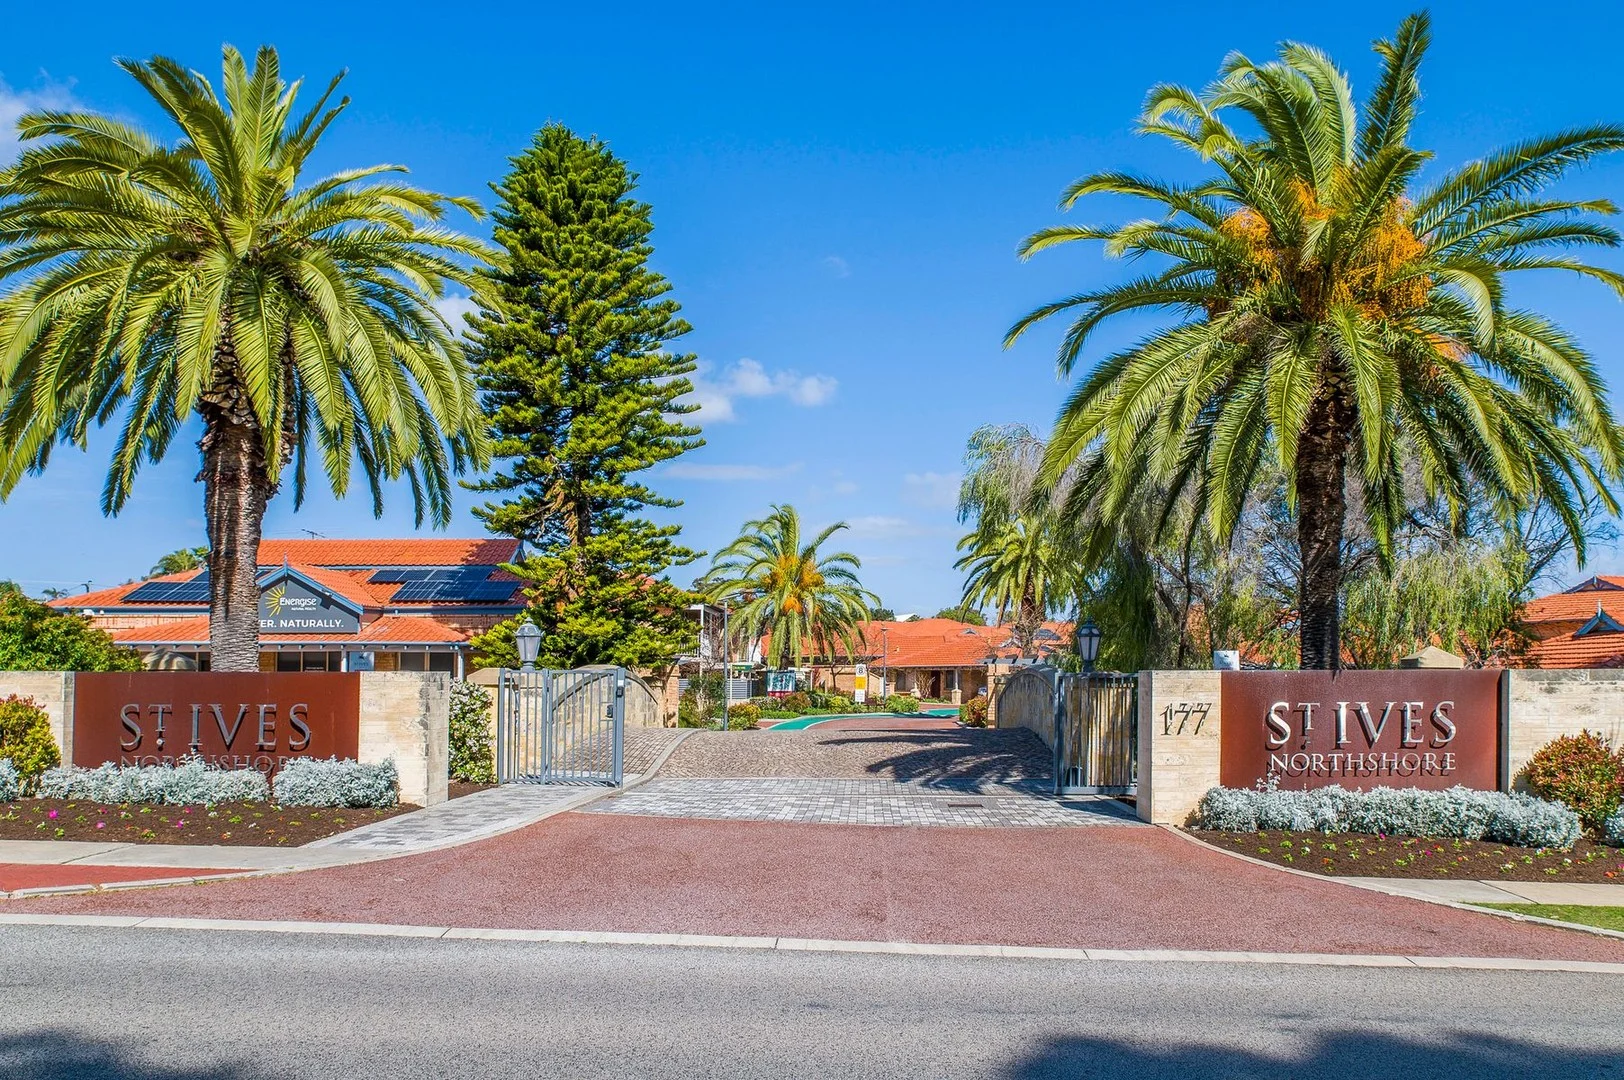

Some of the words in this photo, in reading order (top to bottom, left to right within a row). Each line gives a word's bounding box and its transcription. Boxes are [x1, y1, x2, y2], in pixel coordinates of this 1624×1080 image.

[259, 619, 277, 628] ER.
[280, 619, 344, 628] NATURALLY.
[188, 703, 312, 747] IVES
[1160, 702, 1213, 736] 177
[1336, 700, 1457, 744] IVES
[1270, 752, 1457, 772] NORTHSHORE
